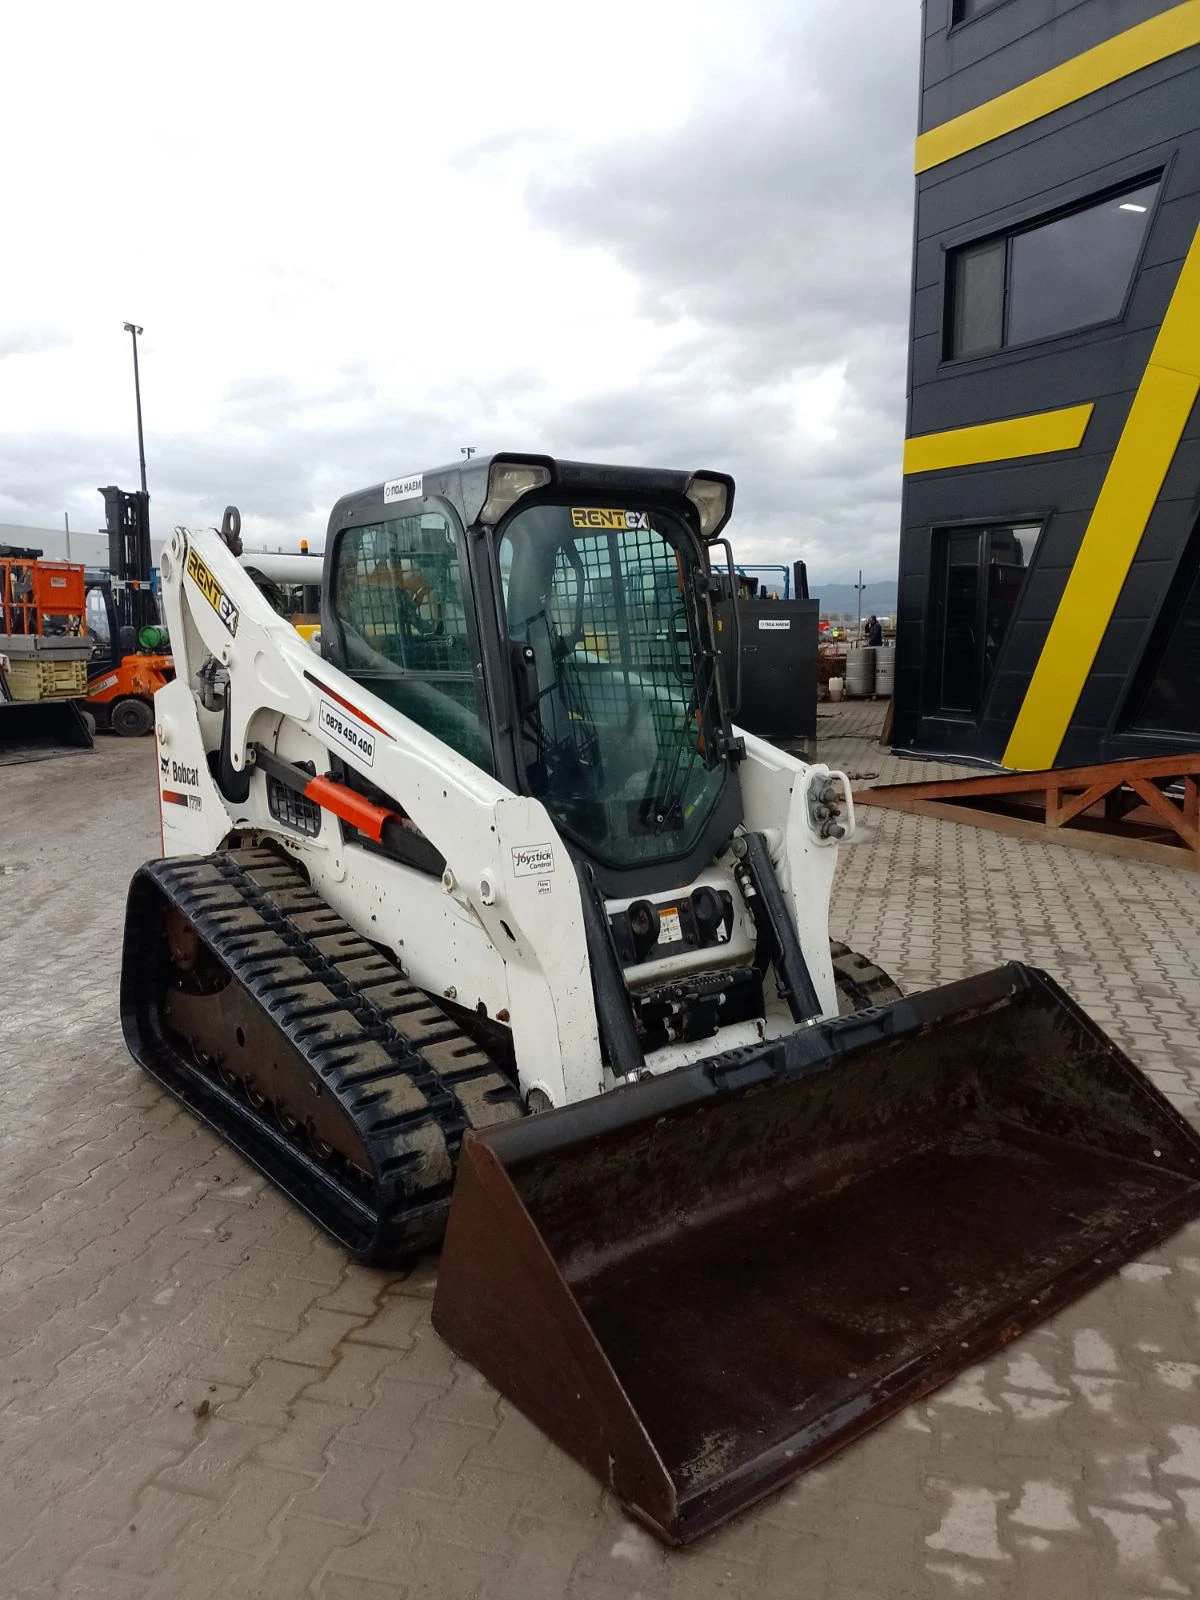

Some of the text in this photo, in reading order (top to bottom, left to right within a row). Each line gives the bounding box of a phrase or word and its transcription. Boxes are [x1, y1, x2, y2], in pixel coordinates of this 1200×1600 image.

[391, 480, 422, 496] ПОД НАЕМ
[573, 509, 648, 529] RENTEX
[190, 551, 237, 632] RENTEX
[326, 713, 373, 757] 0878 450 400
[172, 761, 199, 787] Bobcat
[515, 851, 551, 866] Joystick
[530, 861, 552, 870] Control
